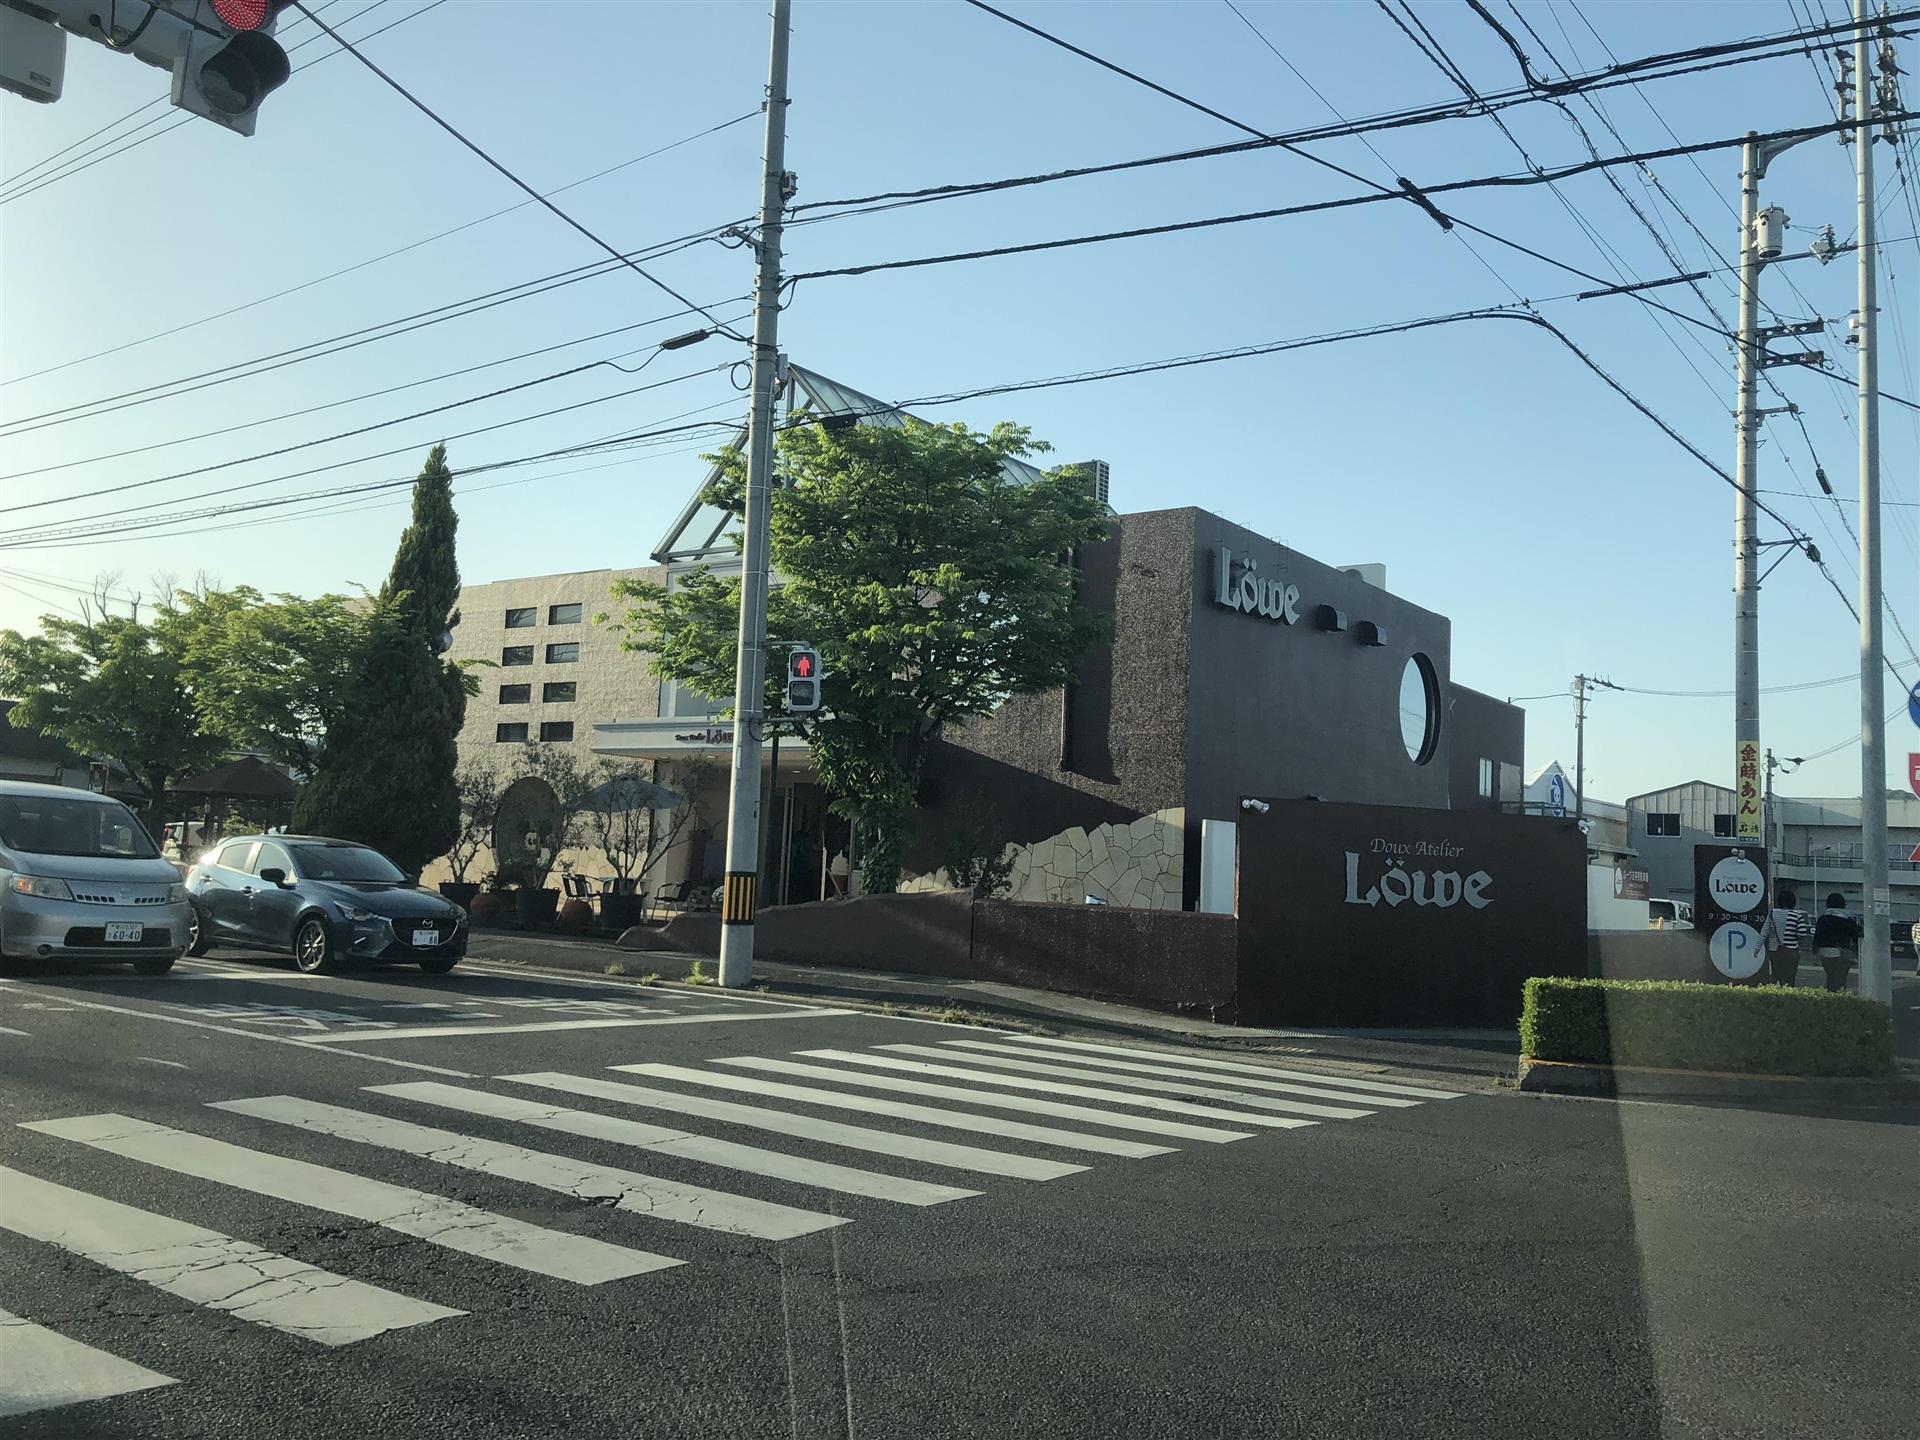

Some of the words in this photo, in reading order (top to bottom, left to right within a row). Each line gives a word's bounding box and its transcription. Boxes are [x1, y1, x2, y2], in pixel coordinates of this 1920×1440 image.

[1215, 547, 1300, 625] Löwe
[1740, 744, 1757, 815] 金時あん
[1370, 838, 1411, 855] Doux
[1415, 839, 1464, 857] Atelier
[1344, 851, 1494, 909] Löwe
[1715, 879, 1758, 894] Löwe
[1727, 930, 1747, 970] P
